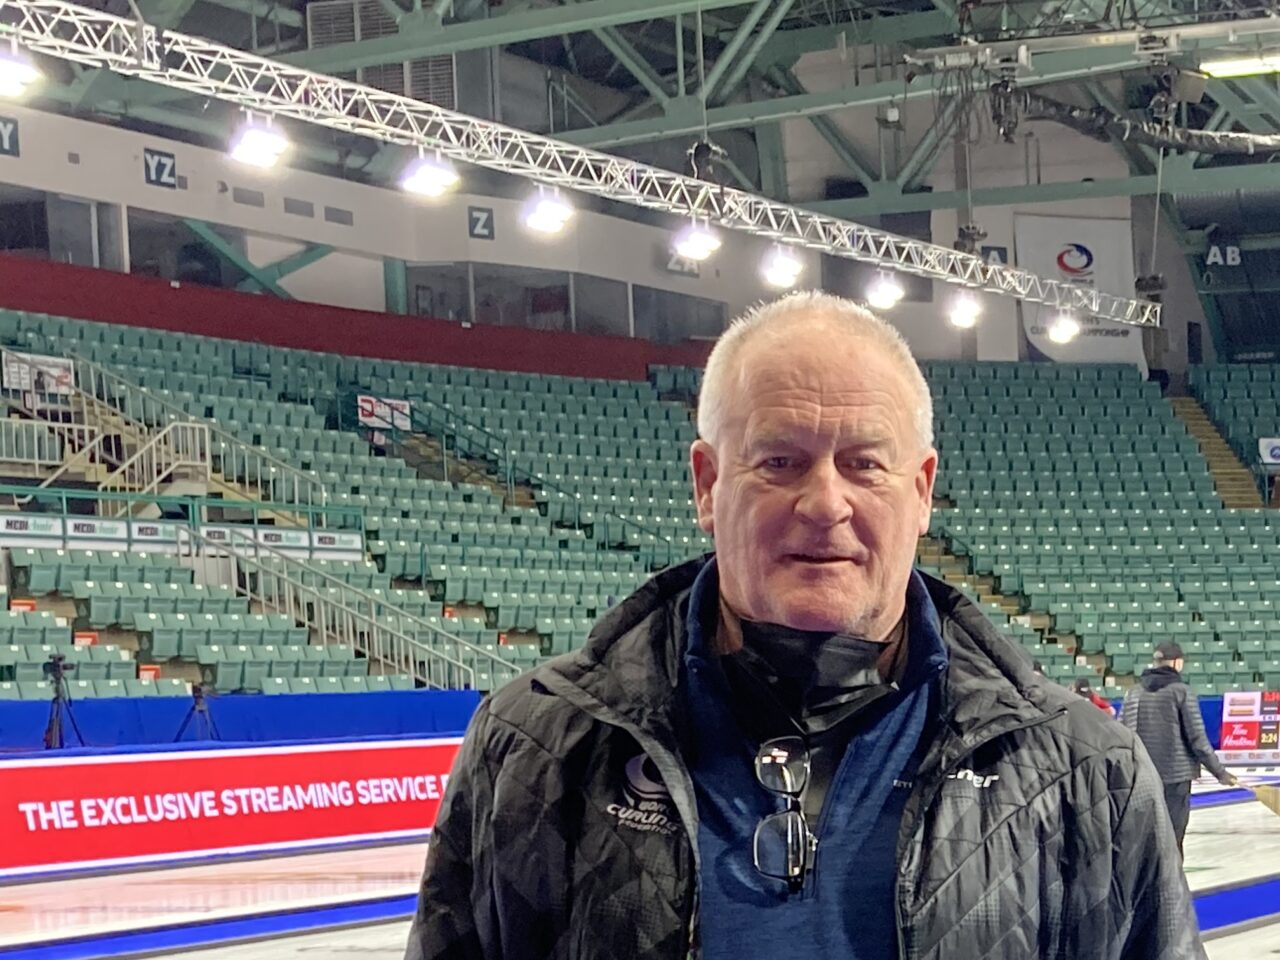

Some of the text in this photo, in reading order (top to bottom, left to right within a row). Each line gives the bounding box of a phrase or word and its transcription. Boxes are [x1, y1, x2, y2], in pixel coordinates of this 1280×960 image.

[145, 151, 176, 185] YZ
[472, 211, 490, 236] Z
[1206, 245, 1242, 266] AB
[1231, 723, 1249, 736] Tim
[18, 799, 79, 832] THE
[80, 790, 220, 828] EXCLUSIVE
[220, 780, 354, 817] STREAMING
[355, 774, 440, 806] SERVICE
[606, 803, 678, 832] CURLING
